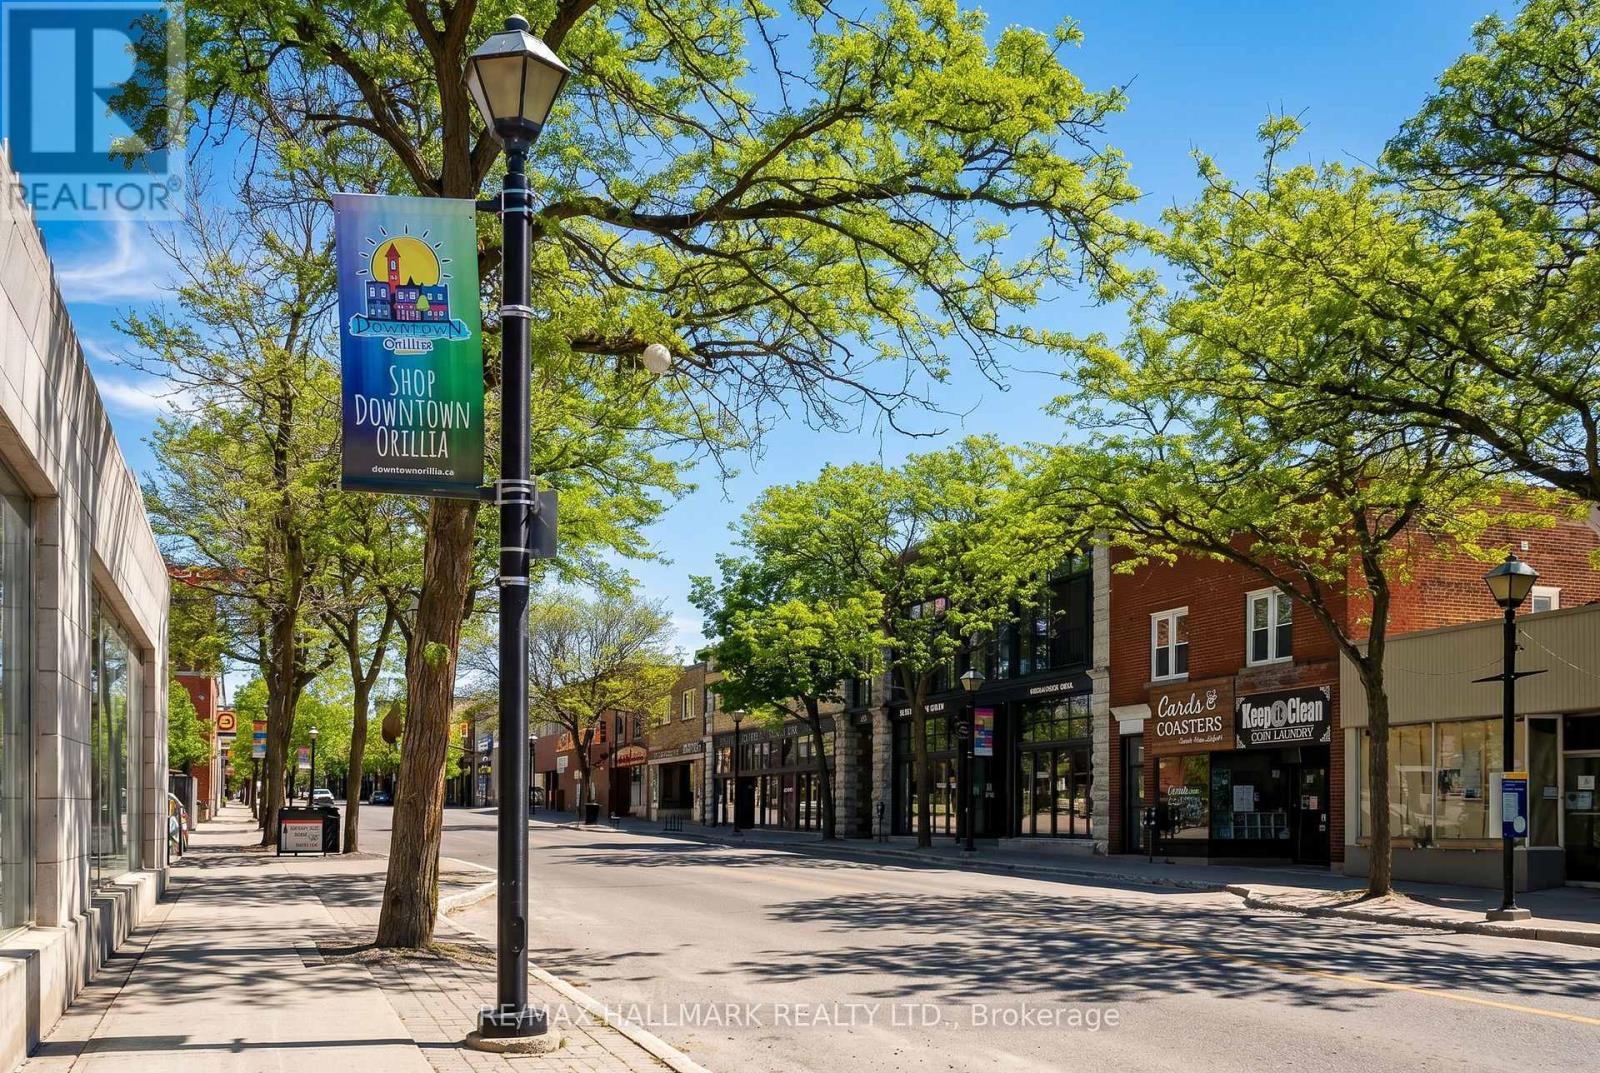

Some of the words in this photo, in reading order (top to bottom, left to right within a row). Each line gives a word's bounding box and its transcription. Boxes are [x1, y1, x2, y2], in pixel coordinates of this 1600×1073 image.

[354, 393, 470, 430] DOWNTOWN
[376, 426, 449, 459] ORILLIA
[371, 465, 455, 477] downtownorillia.ca
[1158, 692, 1204, 718] Cards
[1241, 703, 1271, 729] Keep
[1287, 697, 1323, 724] Clean
[1157, 716, 1222, 737] COASTERS
[1251, 730, 1271, 742] COIN
[1274, 727, 1314, 740] LAUNDRY
